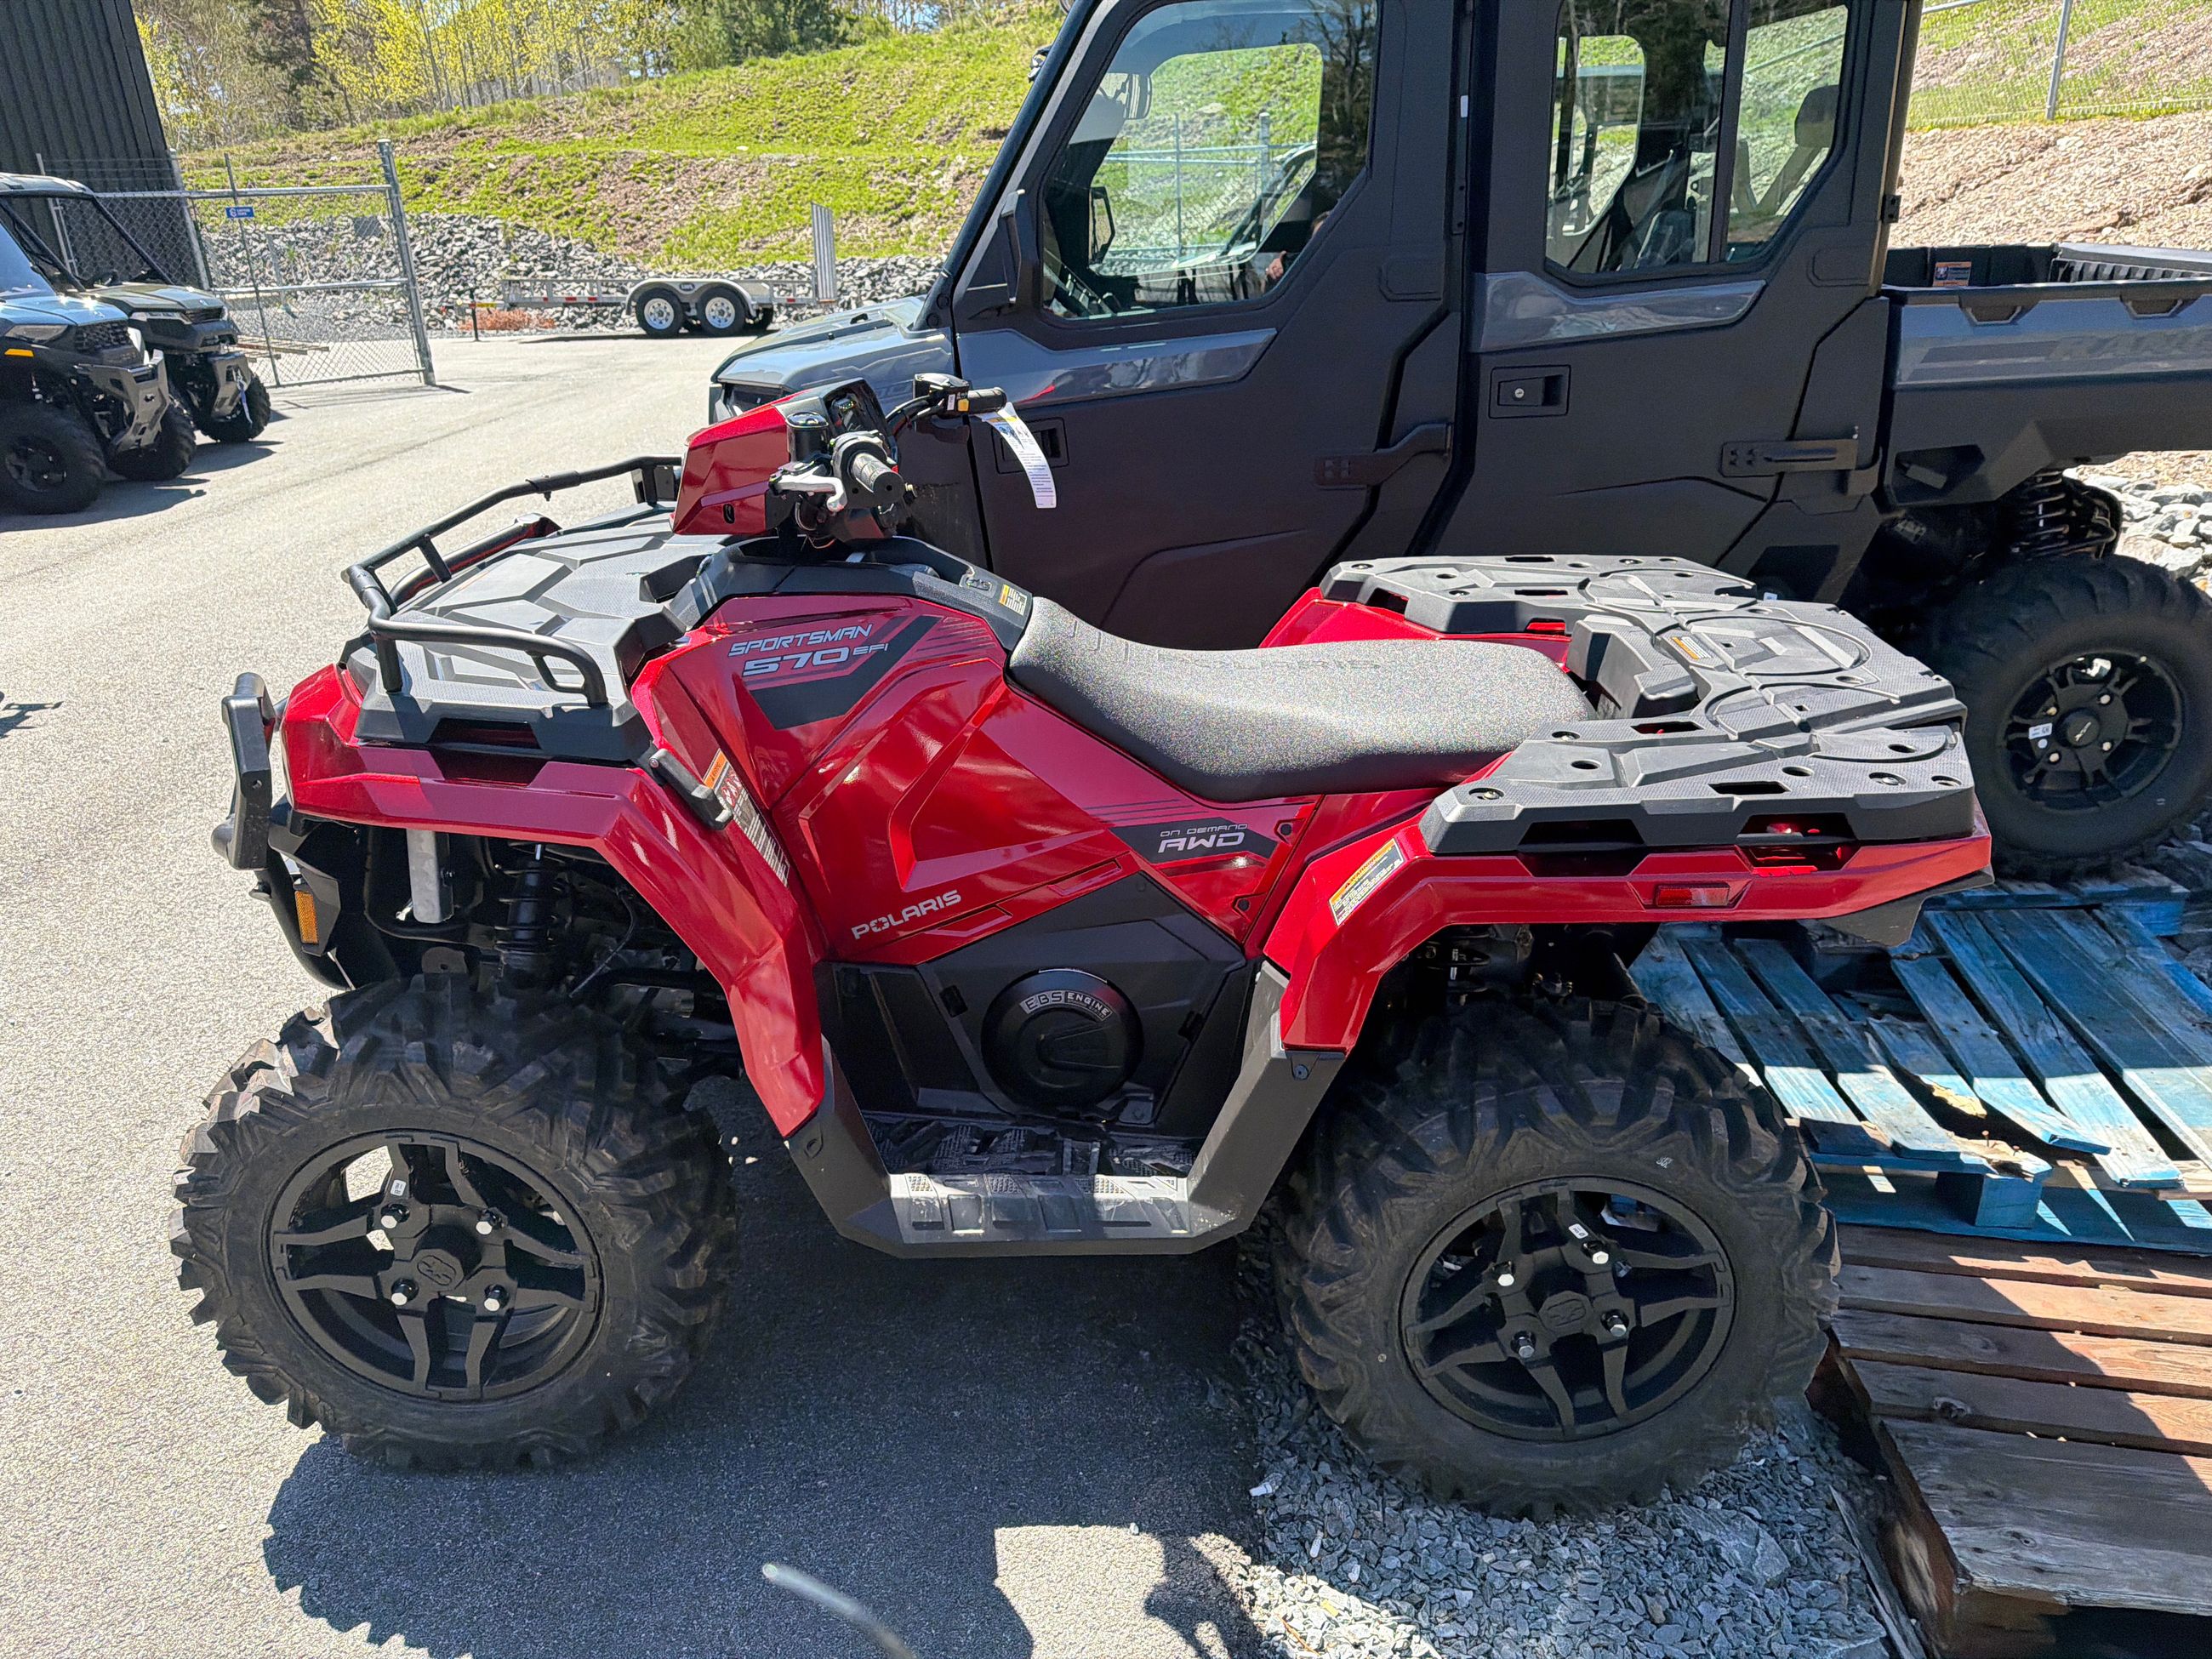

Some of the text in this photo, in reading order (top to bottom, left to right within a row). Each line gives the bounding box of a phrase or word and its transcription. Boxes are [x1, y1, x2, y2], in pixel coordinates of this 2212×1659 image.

[728, 624, 873, 658] SPORTSMAN
[742, 643, 890, 678] 570 EFI
[1158, 831, 1246, 853] AWD
[1187, 824, 1248, 835] DEMAND
[851, 889, 962, 940] POLARIS
[1024, 992, 1109, 1016] EBS ENGINE
